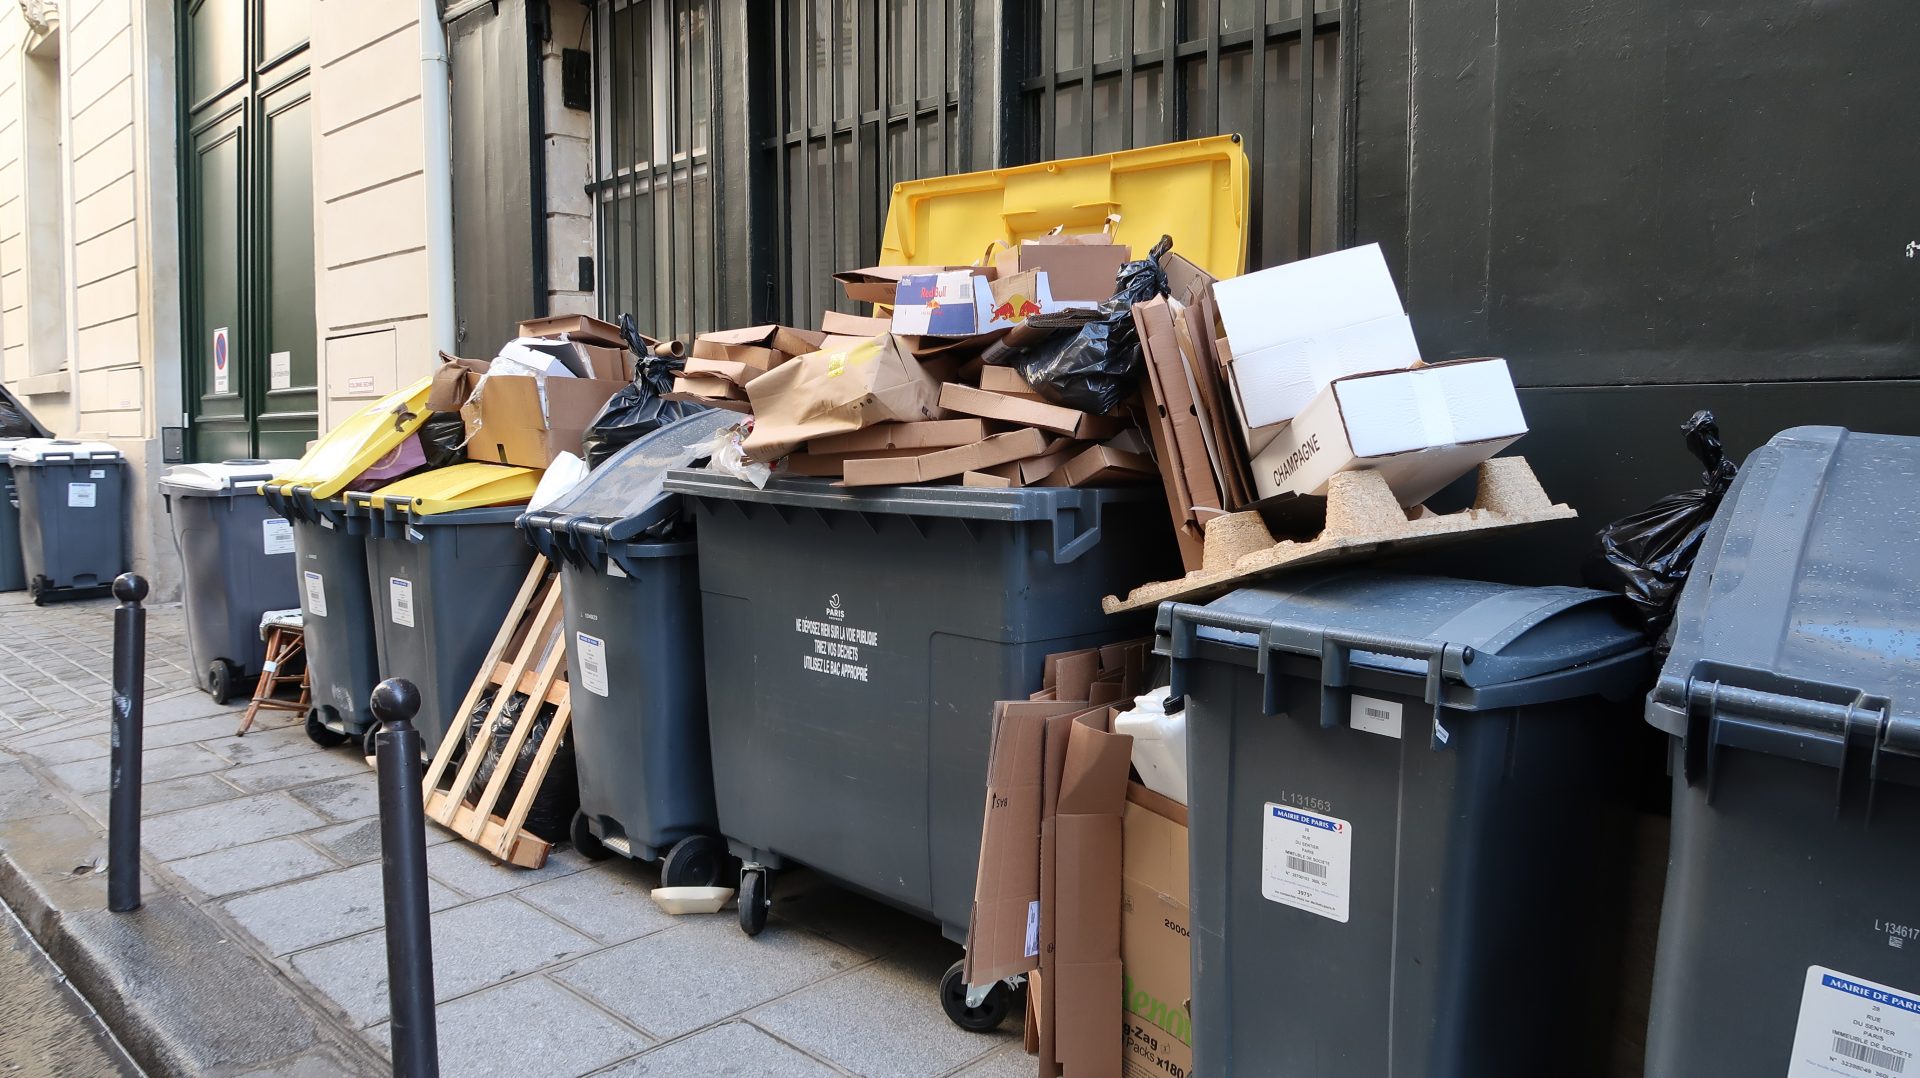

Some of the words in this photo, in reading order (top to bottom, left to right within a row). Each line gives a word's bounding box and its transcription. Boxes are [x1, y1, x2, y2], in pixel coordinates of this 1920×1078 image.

[934, 286, 947, 298] Bull
[1273, 433, 1321, 487] CHAMPAGNE
[826, 608, 844, 618] PARIS
[796, 618, 802, 632] NE
[802, 616, 820, 636] DÉPOSEZ
[820, 622, 830, 638] RIEN
[830, 624, 840, 640] SUR
[840, 626, 846, 640] LA
[846, 627, 856, 642] VOIE
[856, 629, 878, 646] PUBLIQUE
[814, 639, 827, 654] TRIEZ
[827, 642, 837, 656] VOS
[837, 641, 858, 661] DÉCHETS
[804, 655, 823, 672] UTILISEZ
[824, 659, 830, 674] LE
[830, 660, 840, 676] BAC
[840, 664, 868, 682] APPROPRIÉ
[1281, 790, 1287, 801] L
[1290, 793, 1331, 812] 131563
[1278, 810, 1300, 820] MAIRIE
[1301, 816, 1309, 824] DE
[1311, 819, 1329, 828] PARIS
[1875, 920, 1880, 931] L
[1884, 922, 1920, 940] 134617
[1830, 980, 1870, 997] MAIRIE
[1873, 992, 1888, 1001] DE
[1866, 1014, 1881, 1022] RUE
[1863, 1031, 1884, 1041] PARIS
[1865, 1023, 1896, 1036] SENTIER
[1832, 1029, 1868, 1045] IMMEUBLE
[1881, 1045, 1912, 1058] SOCIETE
[1126, 1036, 1154, 1062] Packs
[1156, 1057, 1184, 1078] x180
